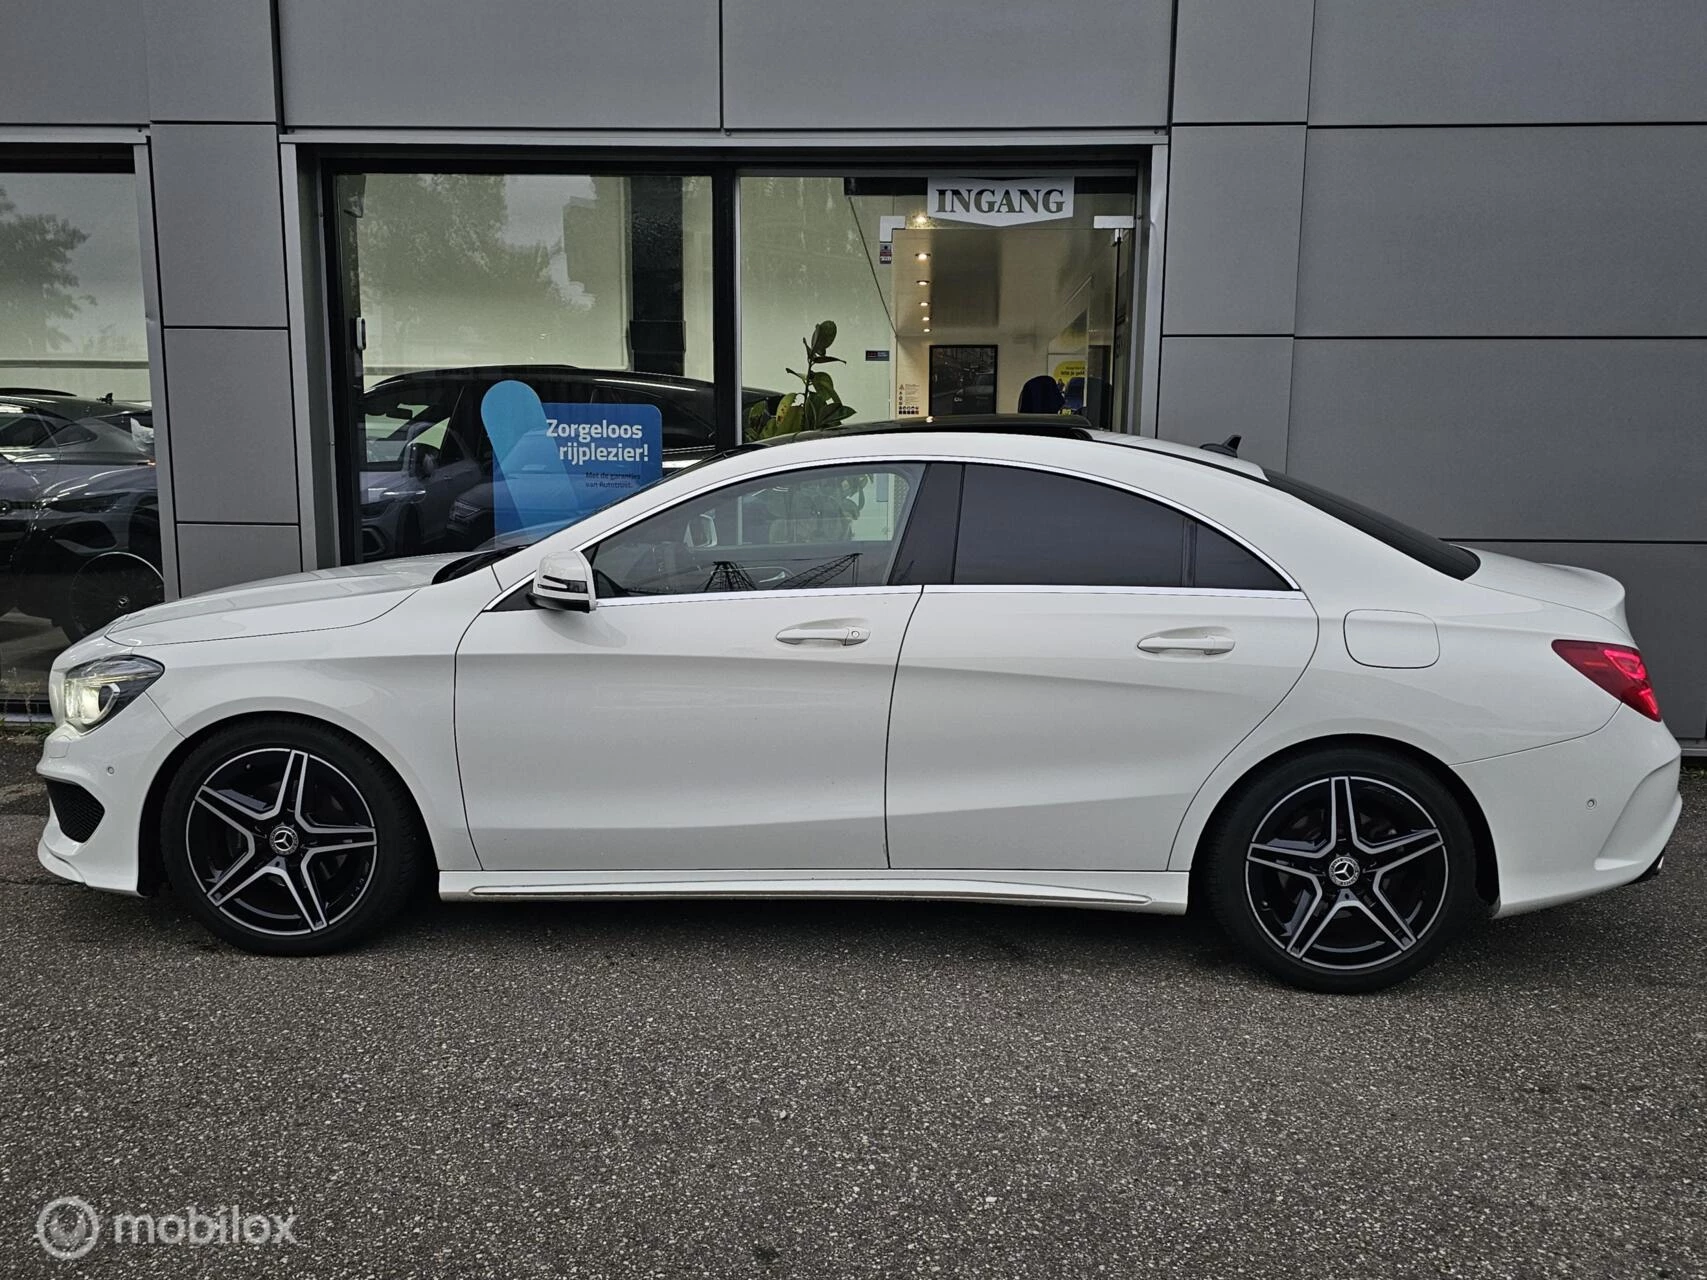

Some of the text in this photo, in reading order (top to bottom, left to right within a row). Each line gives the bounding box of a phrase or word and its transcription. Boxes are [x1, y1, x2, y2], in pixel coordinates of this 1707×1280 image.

[935, 188, 1065, 214] INGANG
[546, 419, 643, 443] Zorgeloos
[559, 442, 649, 466] rijplezier!
